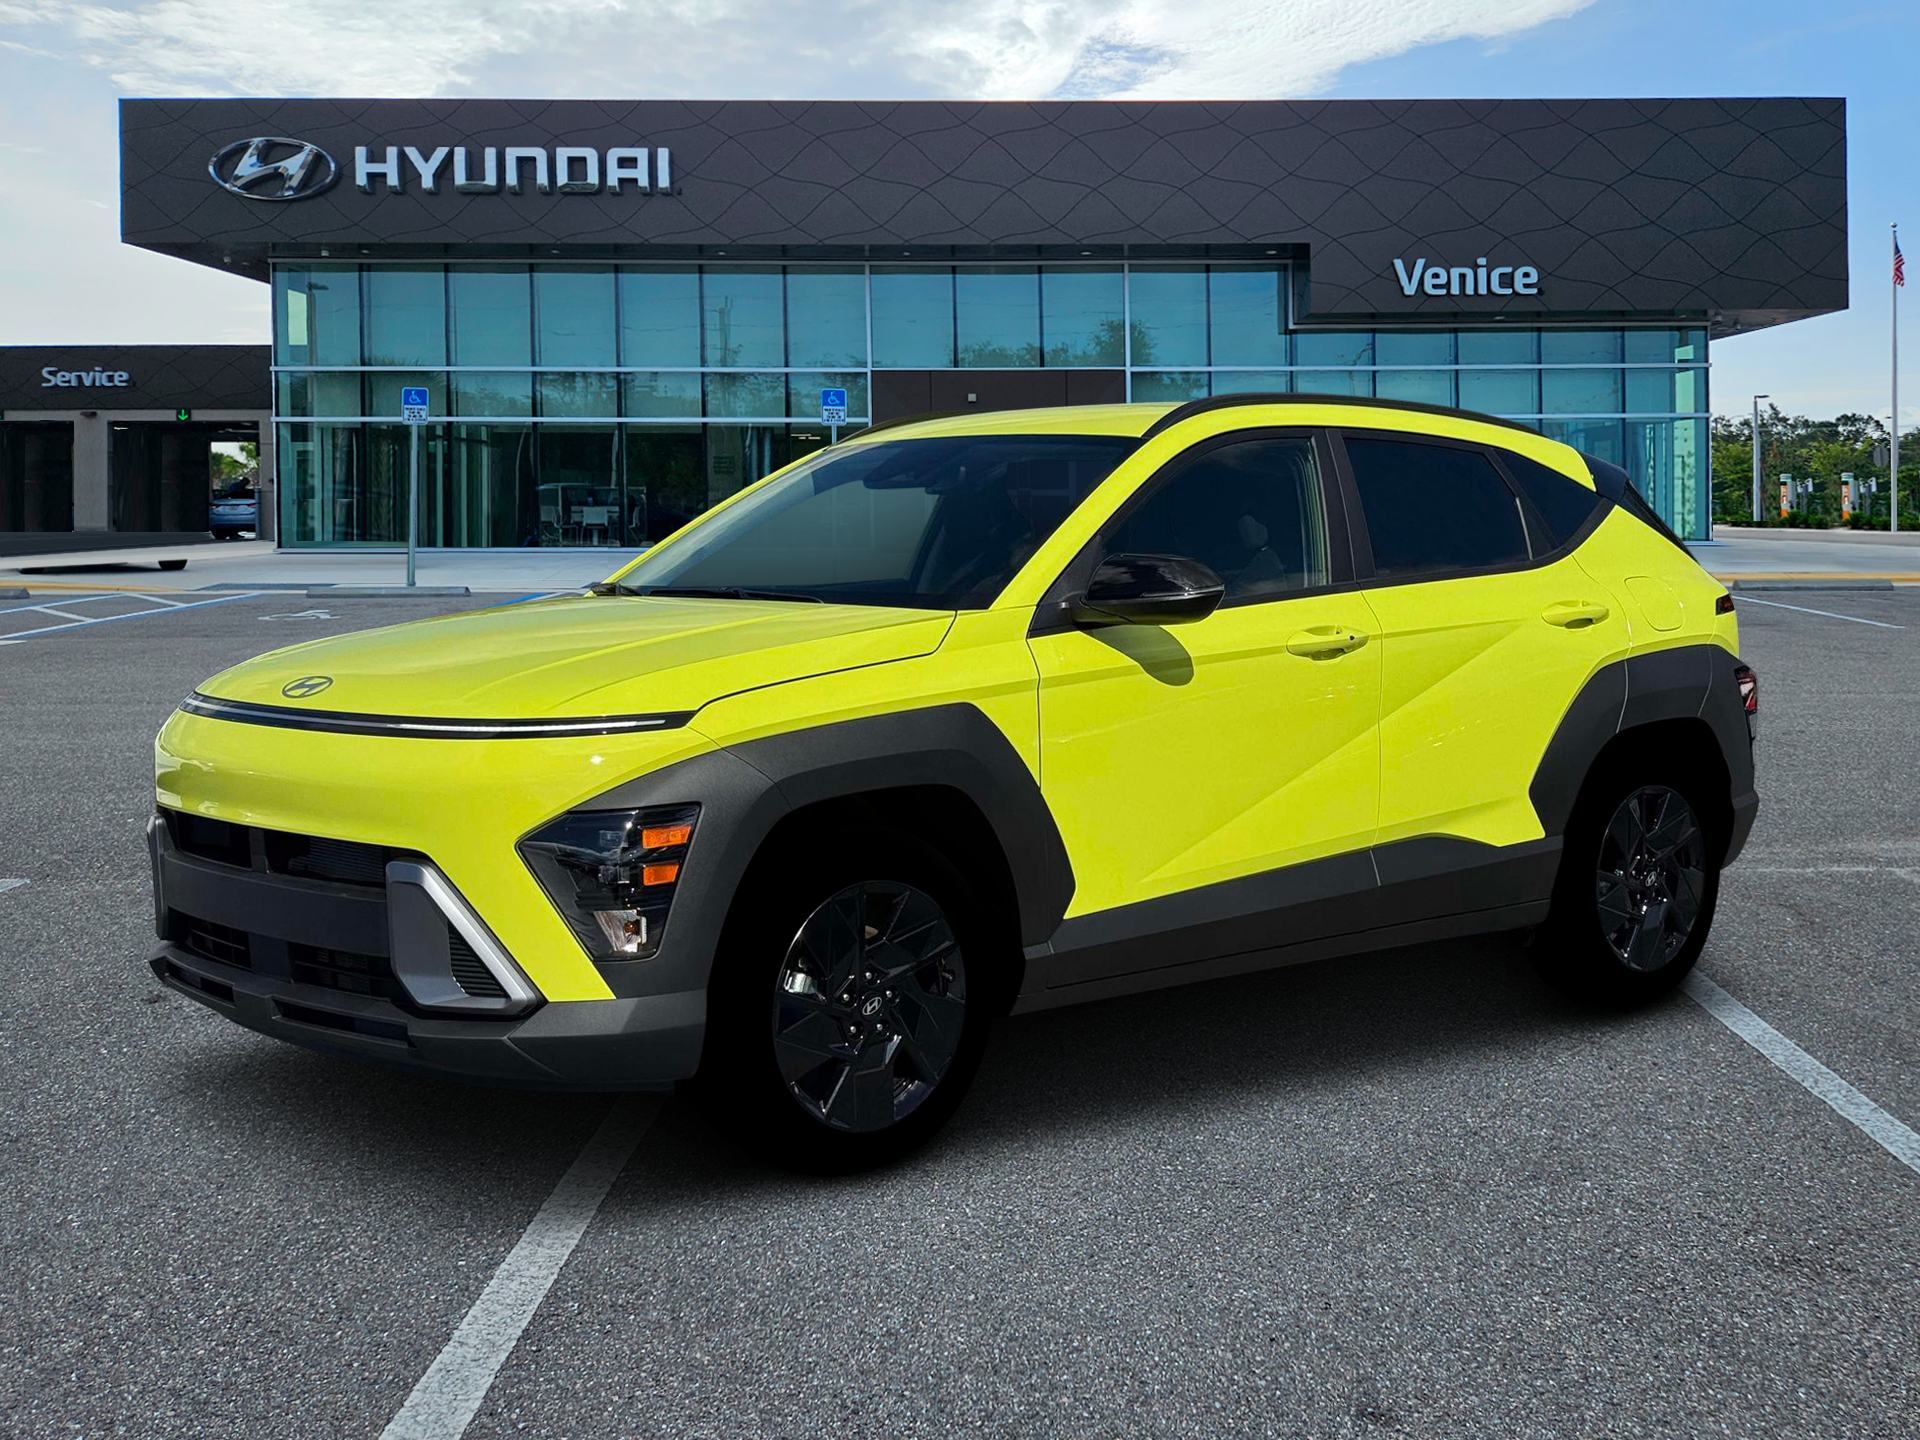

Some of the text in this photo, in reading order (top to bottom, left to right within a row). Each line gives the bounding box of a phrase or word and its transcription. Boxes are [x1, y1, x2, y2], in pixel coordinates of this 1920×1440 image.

[354, 146, 671, 195] HYUNDAI
[1392, 256, 1540, 296] Venice
[41, 366, 130, 387] Service
